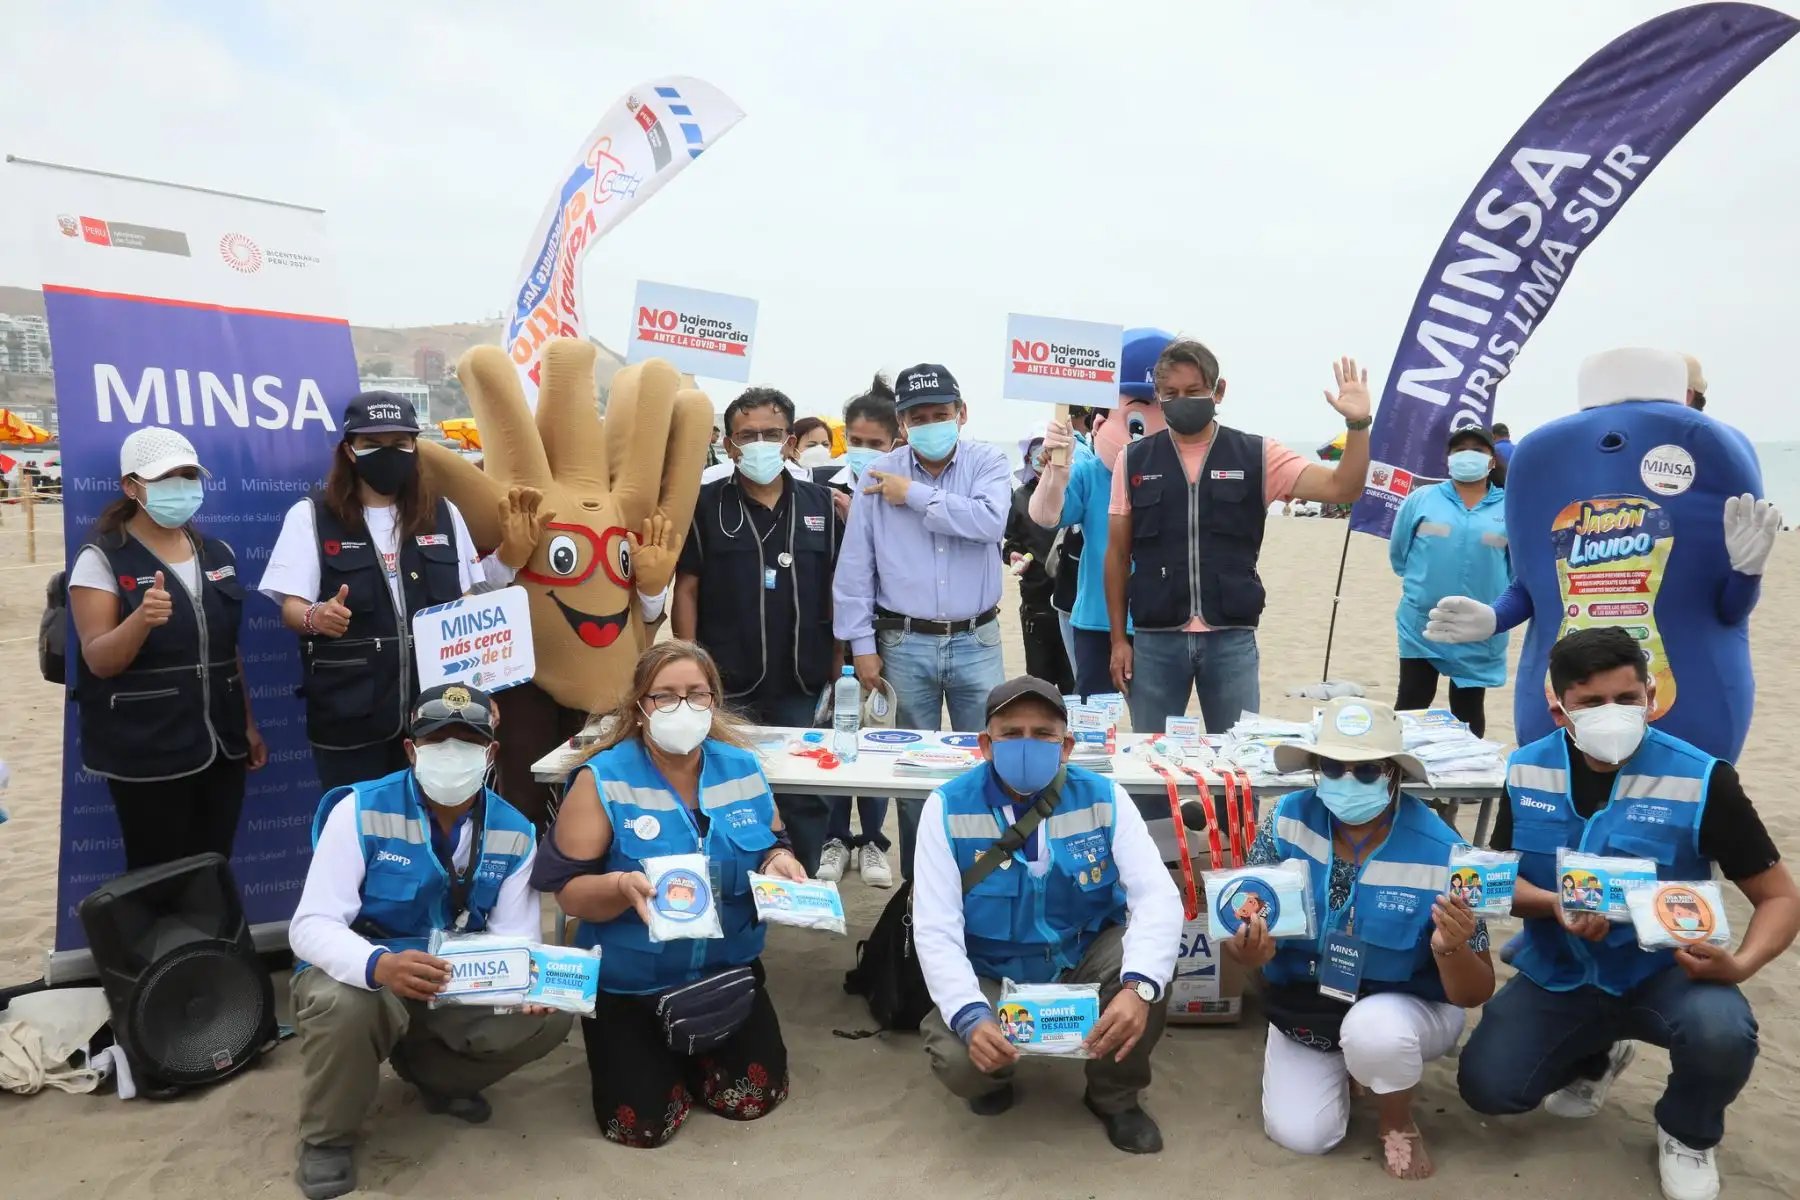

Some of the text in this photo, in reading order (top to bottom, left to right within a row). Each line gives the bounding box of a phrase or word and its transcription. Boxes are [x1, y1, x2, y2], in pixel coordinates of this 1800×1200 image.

[1504, 238, 1578, 335] LIMA
[1562, 143, 1650, 234] SUR
[1396, 146, 1592, 407] MINSA
[638, 305, 678, 331] NO
[679, 312, 733, 331] bajemos
[683, 321, 749, 343] la guardia
[653, 333, 727, 352] ANTE LA COVID-19
[1012, 339, 1049, 362] NO
[1050, 343, 1100, 358] bajemos
[1055, 354, 1116, 369] la guardia
[1027, 364, 1097, 380] ANTE LA COVID-19
[909, 378, 940, 391] Salud
[93, 363, 337, 433] MINSA
[369, 409, 402, 420] Salud
[1644, 459, 1693, 477] MINSA
[241, 478, 311, 492] Ministerio
[1575, 505, 1646, 535] JABÓN
[1570, 533, 1653, 563] LÍQUIDO
[441, 606, 507, 640] MINSA
[440, 629, 512, 660] más cerca
[482, 648, 498, 665] de
[1330, 943, 1359, 958] MINSA
[451, 960, 510, 978] MINSA
[545, 971, 590, 981] COMUNITARIO
[546, 961, 583, 974] COMITÉ
[556, 978, 584, 988] SALUD
[1040, 1004, 1076, 1017] COMITÉ
[1041, 1015, 1085, 1023] COMUNITARIO
[1054, 1021, 1080, 1029] SALUD
